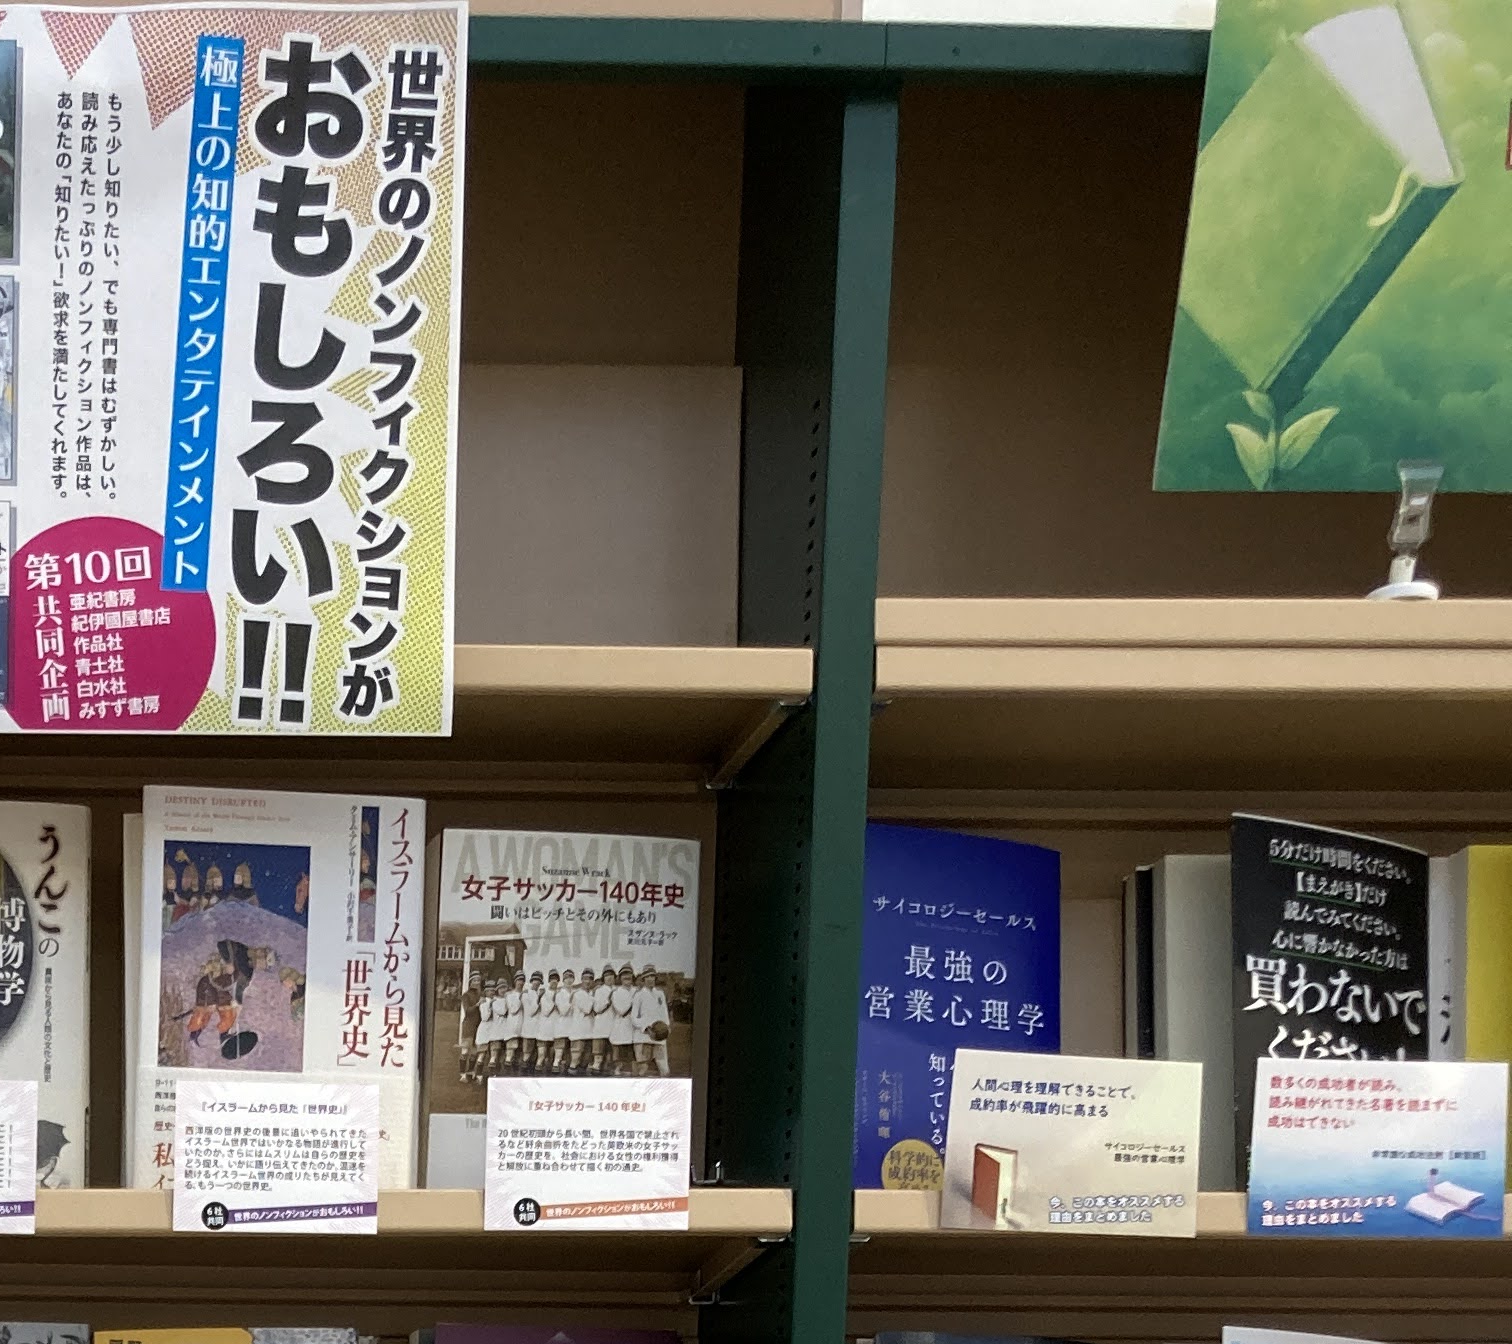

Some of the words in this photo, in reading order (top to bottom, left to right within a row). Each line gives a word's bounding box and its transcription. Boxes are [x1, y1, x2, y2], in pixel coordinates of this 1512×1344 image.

[168, 43, 240, 586] 極上の知的エンタテインメント
[234, 38, 375, 719] おもしろい!!
[336, 48, 443, 719] 世界のノンフィクションが
[27, 549, 152, 591] 第10回
[69, 588, 136, 609] 亜紀書房
[72, 609, 172, 631] 紀伊國屋書店
[35, 598, 68, 723] 共同企画
[73, 633, 124, 654] 作品社
[75, 654, 126, 675] 青土社
[76, 677, 127, 698] 白水社
[78, 695, 160, 719] みすず書房
[33, 825, 69, 958] うんこの
[461, 876, 685, 909] 女子サッカー140年史
[380, 807, 411, 1068] イスラームから見た
[904, 945, 1008, 987] 最強の
[864, 986, 1045, 1036] 営業心理学
[1244, 954, 1426, 1034] 買わないで
